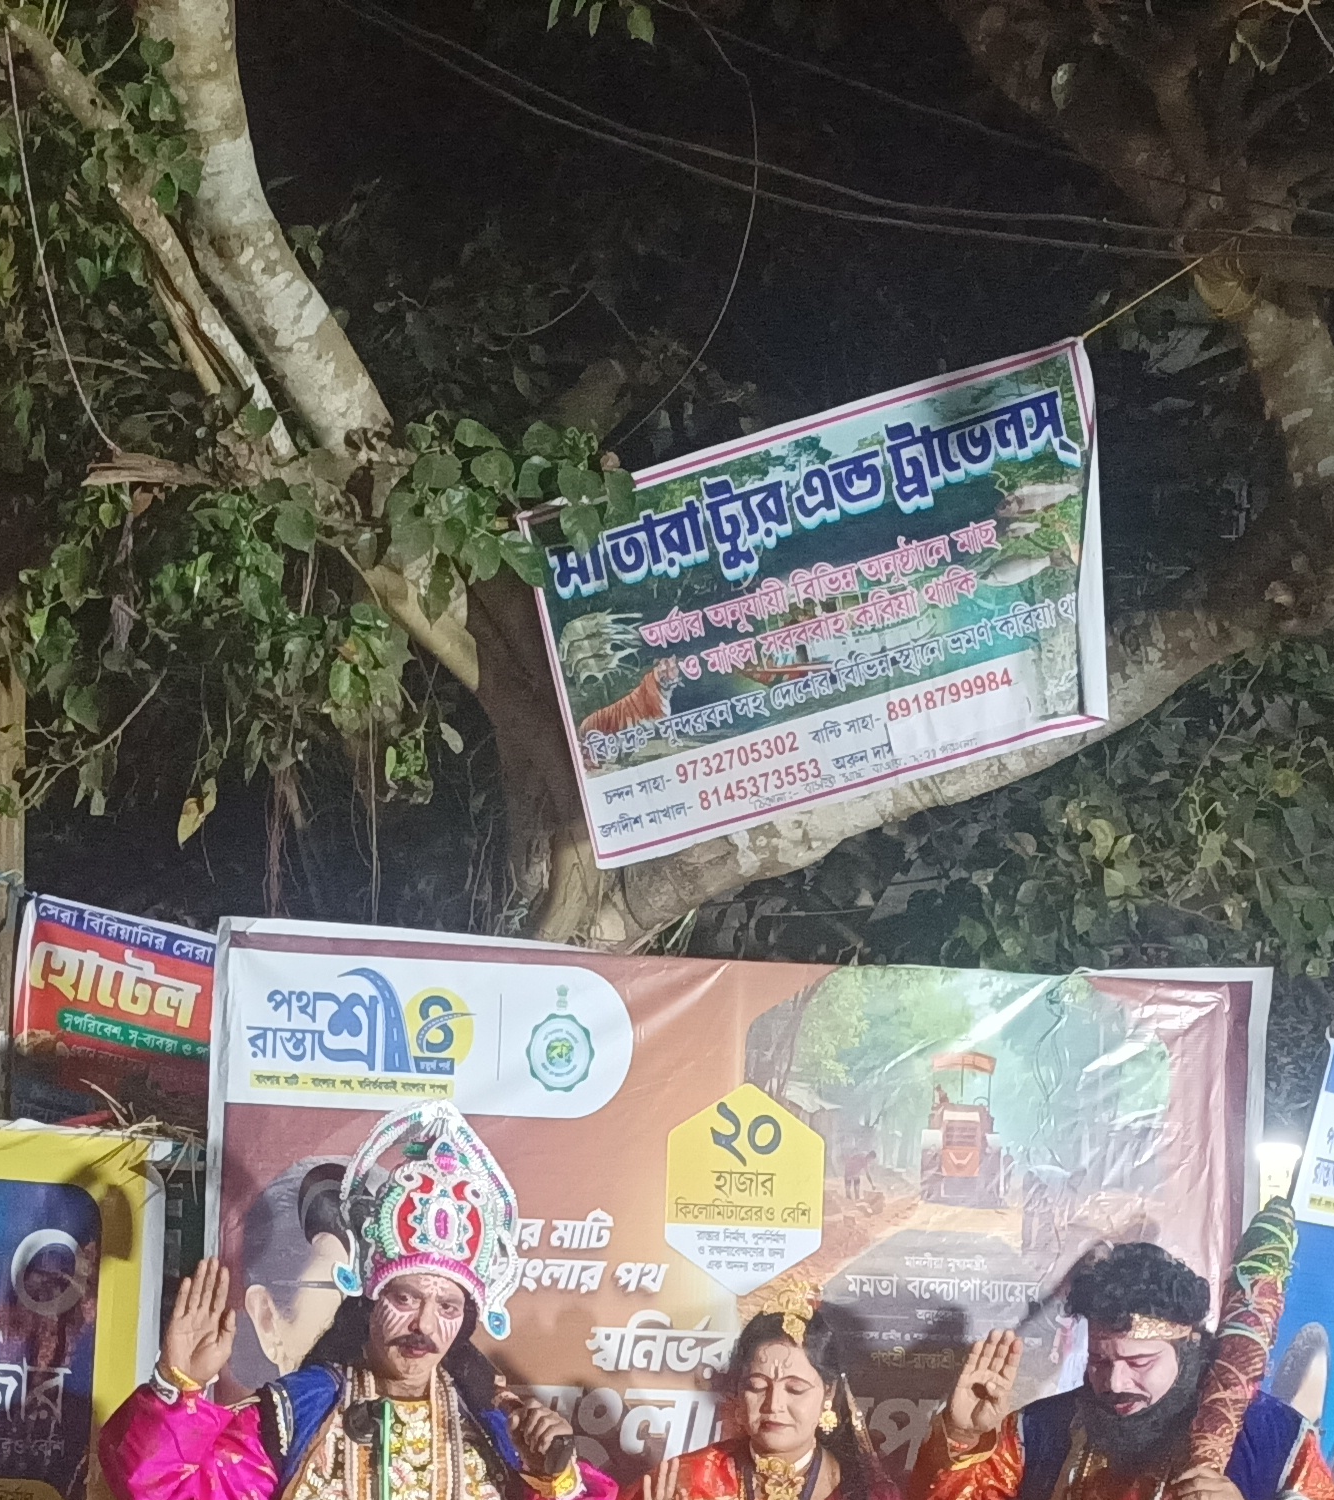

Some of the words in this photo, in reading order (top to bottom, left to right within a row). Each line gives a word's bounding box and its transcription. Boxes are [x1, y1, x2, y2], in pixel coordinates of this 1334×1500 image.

[604, 500, 707, 578] তারা
[789, 562, 859, 608] বিভিন্ন
[951, 520, 1003, 552] মাছ
[679, 655, 701, 679] ও
[701, 636, 757, 675] মাংস
[853, 589, 917, 627] করিয়া
[924, 566, 978, 608] থাকি
[657, 700, 732, 747] সুন্দরবন
[731, 689, 770, 719] সহ
[770, 672, 831, 710] দেশের
[833, 650, 894, 689] বিভিন্ন
[603, 783, 634, 805] চন্দন
[675, 731, 800, 784] 9732705302
[885, 667, 1013, 721] 8918799984
[698, 758, 822, 812] 8145373553
[39, 901, 77, 925] সেরা
[82, 911, 166, 950] বিরিয়ানির
[173, 938, 213, 964] সেরা
[29, 940, 201, 1028] হোটেল
[710, 1101, 782, 1167] ২০
[710, 1169, 776, 1197] হাজার
[781, 1202, 812, 1224] বেশি
[550, 1208, 615, 1250] মাটি
[614, 1262, 669, 1293] পথ
[845, 1274, 899, 1298] মমতা
[906, 1277, 1042, 1302] বন্দ্যোপাধ্যায়ের
